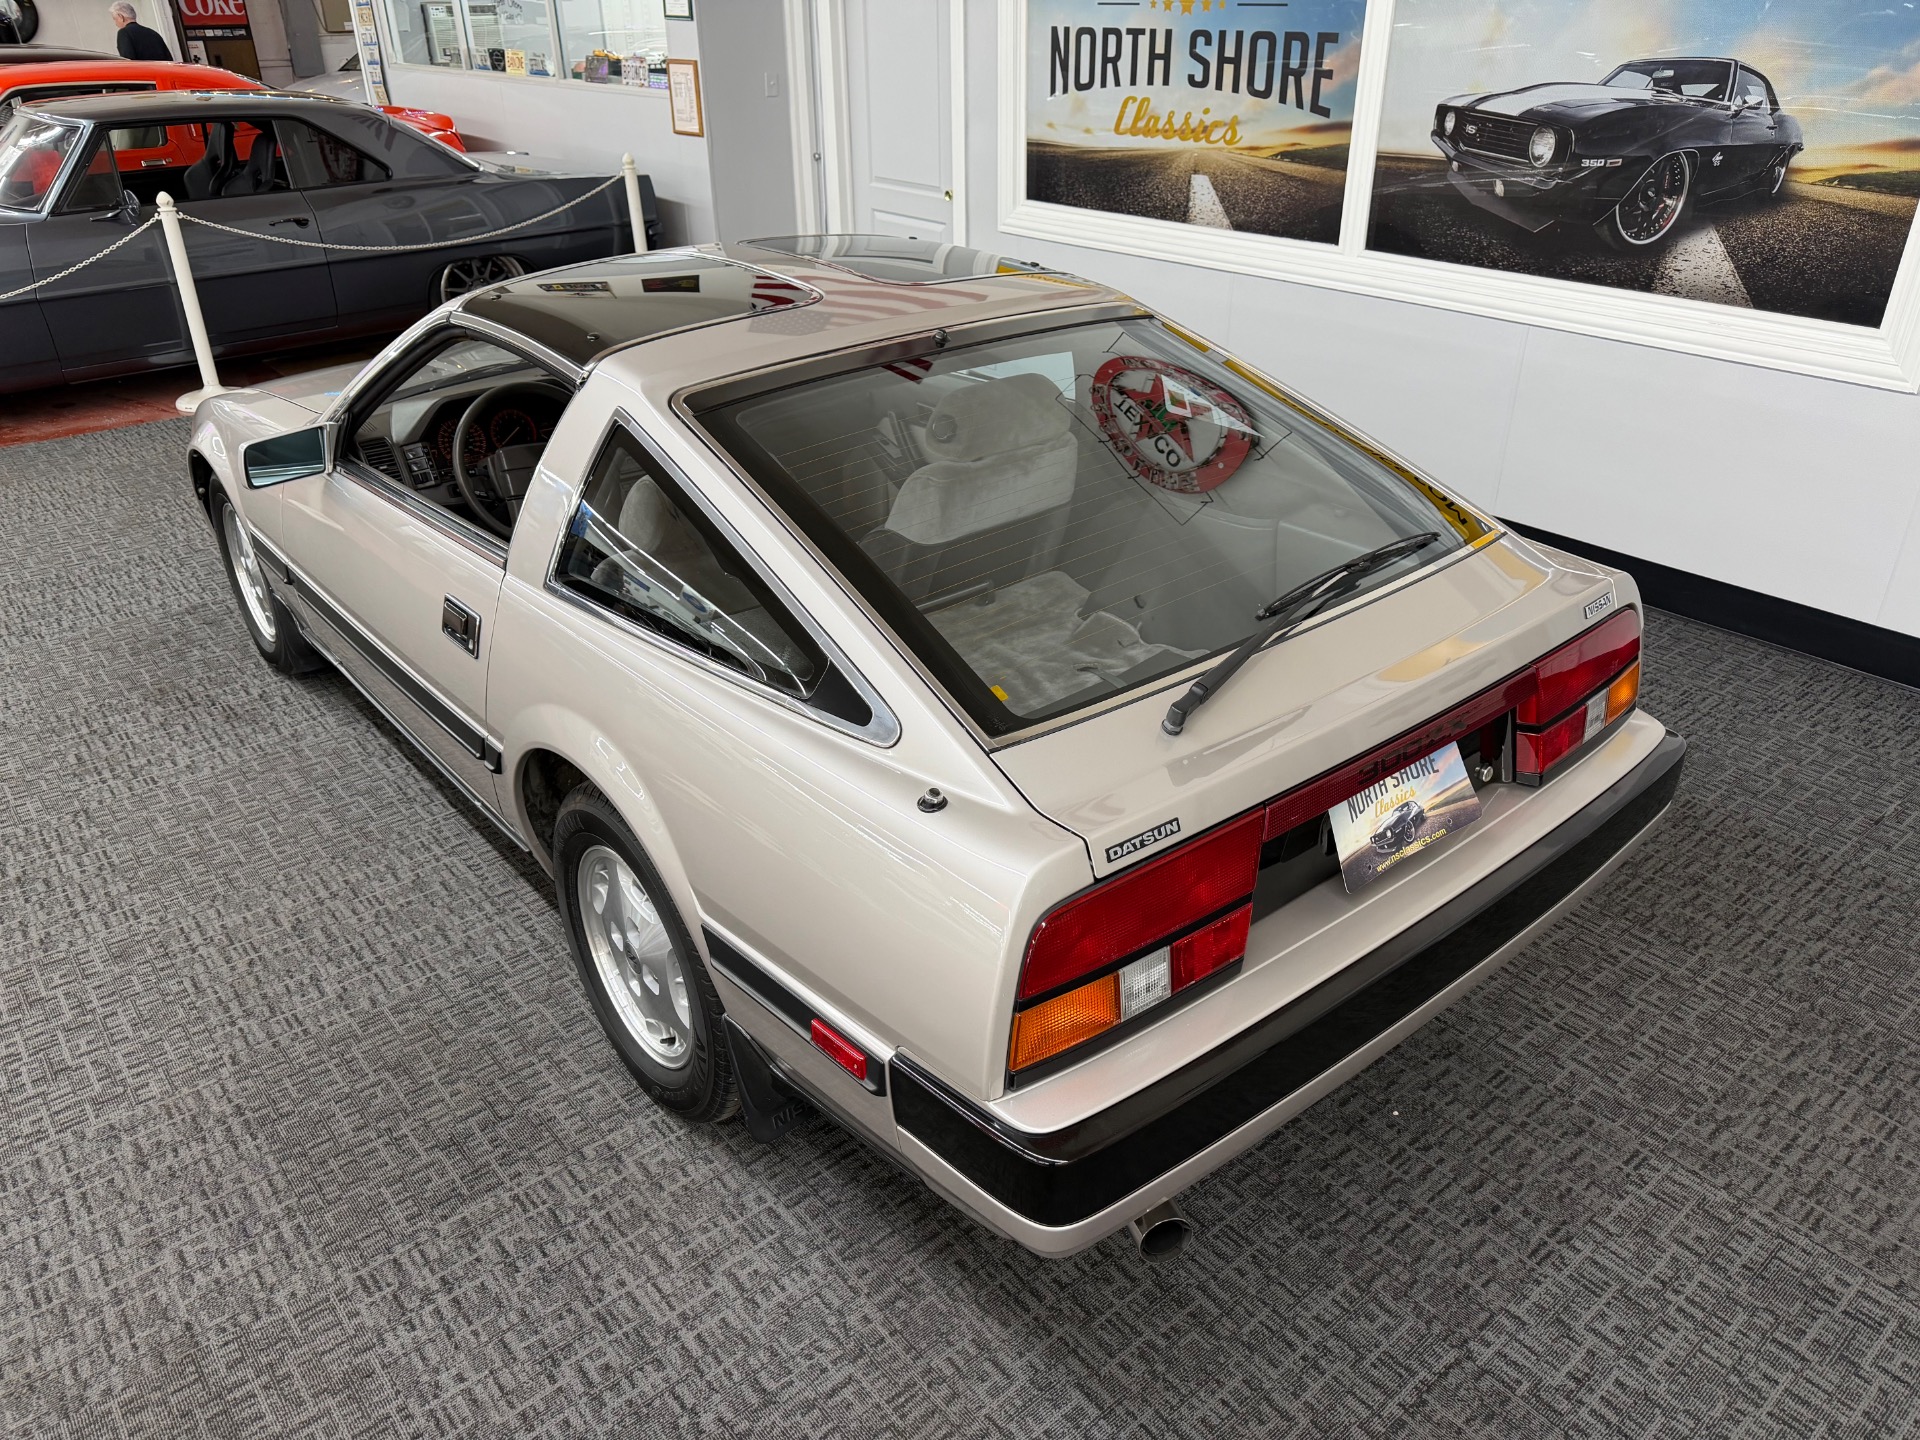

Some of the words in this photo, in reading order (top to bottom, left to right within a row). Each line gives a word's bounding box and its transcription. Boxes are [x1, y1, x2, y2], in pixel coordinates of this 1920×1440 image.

[1050, 26, 1173, 97] NORTH
[1187, 29, 1340, 119] SHORE
[1113, 95, 1243, 146] Classics
[1581, 159, 1605, 167] 350
[1587, 595, 1611, 616] NISSAN
[1346, 777, 1389, 824] NORTH
[1392, 755, 1440, 789] SHORE
[1375, 786, 1417, 819] Classics
[1108, 820, 1179, 861] DATSUN
[1376, 828, 1447, 873] www.nsclassics.com
